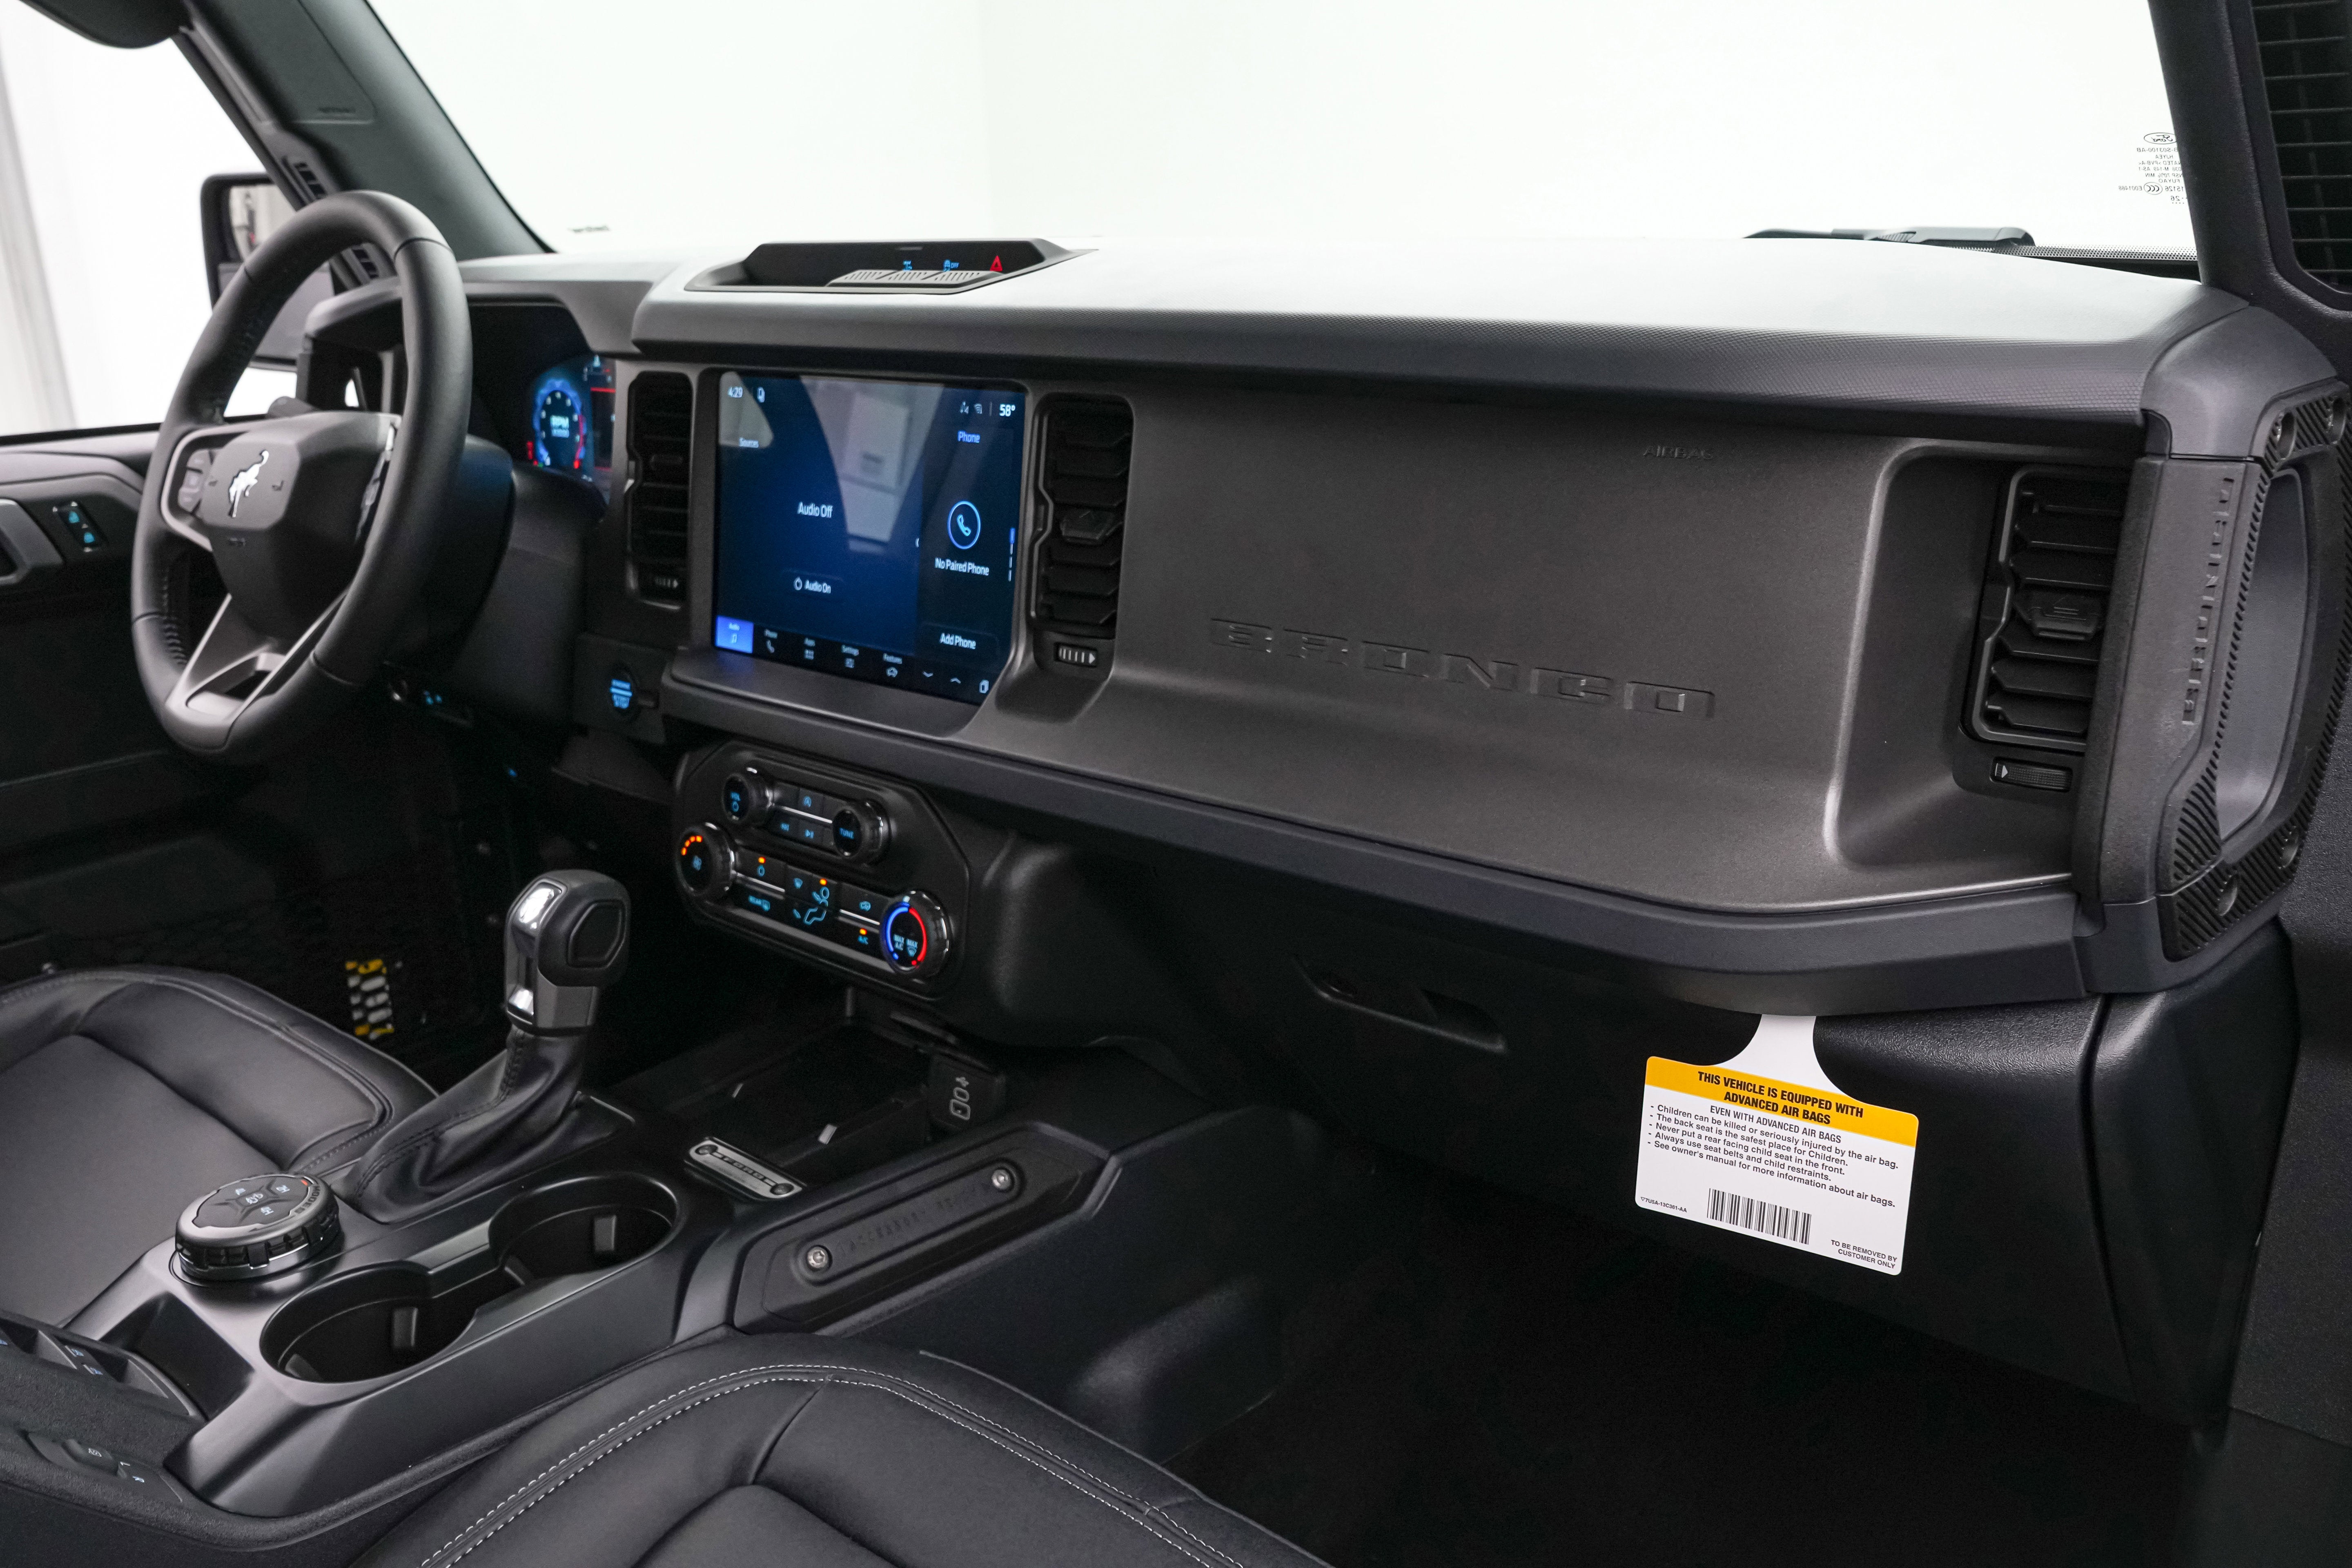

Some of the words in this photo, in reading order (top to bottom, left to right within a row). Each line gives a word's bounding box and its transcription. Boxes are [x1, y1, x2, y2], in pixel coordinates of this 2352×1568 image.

[958, 430, 980, 443] Phone
[797, 501, 819, 517] Audio
[820, 506, 833, 519] Off
[935, 557, 945, 570] No
[945, 559, 967, 574] Paired
[967, 562, 989, 577] Phone
[804, 579, 821, 593] Audio
[822, 583, 831, 594] On
[940, 633, 953, 645] Add
[954, 634, 976, 650] Phone
[839, 827, 854, 839] TUNE
[1697, 1071, 1720, 1085] THIS
[1723, 1076, 1765, 1095] VEHICLE
[1767, 1087, 1777, 1098] IS
[1780, 1090, 1832, 1110] EQUIPPED
[1835, 1102, 1863, 1118] WITH
[1724, 1091, 1778, 1112] ADVANCED
[1781, 1105, 1799, 1117] AIR
[1802, 1109, 1831, 1125] BAGS
[1657, 1104, 1692, 1118] Children
[1694, 1114, 1709, 1123] can
[1711, 1116, 1722, 1125] be
[1724, 1120, 1746, 1131] killed
[1760, 1130, 1799, 1145] seriously
[1802, 1138, 1832, 1152] injured
[1835, 1146, 1846, 1157] by
[1848, 1150, 1862, 1159] the
[1864, 1155, 1876, 1163] air
[1879, 1157, 1898, 1169] bag.
[1710, 1105, 1731, 1117] EVEN
[1733, 1110, 1754, 1123] WITH
[1756, 1116, 1799, 1133] ADVANCED
[1801, 1127, 1816, 1138] AIR
[1818, 1131, 1841, 1143] BAGS
[1656, 1113, 1672, 1123] The
[1674, 1117, 1693, 1128] back
[1695, 1124, 1713, 1133] seat
[1715, 1127, 1722, 1135] is
[1725, 1130, 1738, 1139] the
[1740, 1135, 1766, 1146] safest
[1768, 1141, 1791, 1152] place
[1794, 1146, 1806, 1155] for
[1808, 1150, 1848, 1166] Children.
[1656, 1122, 1679, 1134] Never
[1681, 1129, 1695, 1138] put
[1704, 1135, 1721, 1144] rear
[1723, 1138, 1748, 1152] facing
[1751, 1146, 1772, 1156] child
[1774, 1152, 1792, 1162] seat
[1795, 1156, 1802, 1164] in
[1805, 1159, 1819, 1168] the
[1821, 1163, 1844, 1175] front.
[1655, 1131, 1684, 1144] Always
[1686, 1140, 1702, 1148] use
[1704, 1144, 1721, 1154] seat
[1723, 1147, 1743, 1159] belts
[1746, 1155, 1762, 1163] and
[1764, 1159, 1785, 1169] child
[1787, 1165, 1831, 1181] restraints.
[1654, 1140, 1669, 1150] See
[1671, 1146, 1703, 1158] owner's
[1706, 1154, 1736, 1166] manual
[1738, 1161, 1751, 1170] for
[1753, 1166, 1774, 1176] more
[1777, 1170, 1826, 1189] information
[1829, 1185, 1854, 1197] about
[1856, 1192, 1868, 1200] air
[1870, 1194, 1895, 1207] bags.
[1838, 1248, 1875, 1263] CUSTOMER
[1877, 1259, 1895, 1269] ONLY
[1852, 1245, 1886, 1259] REMOVED
